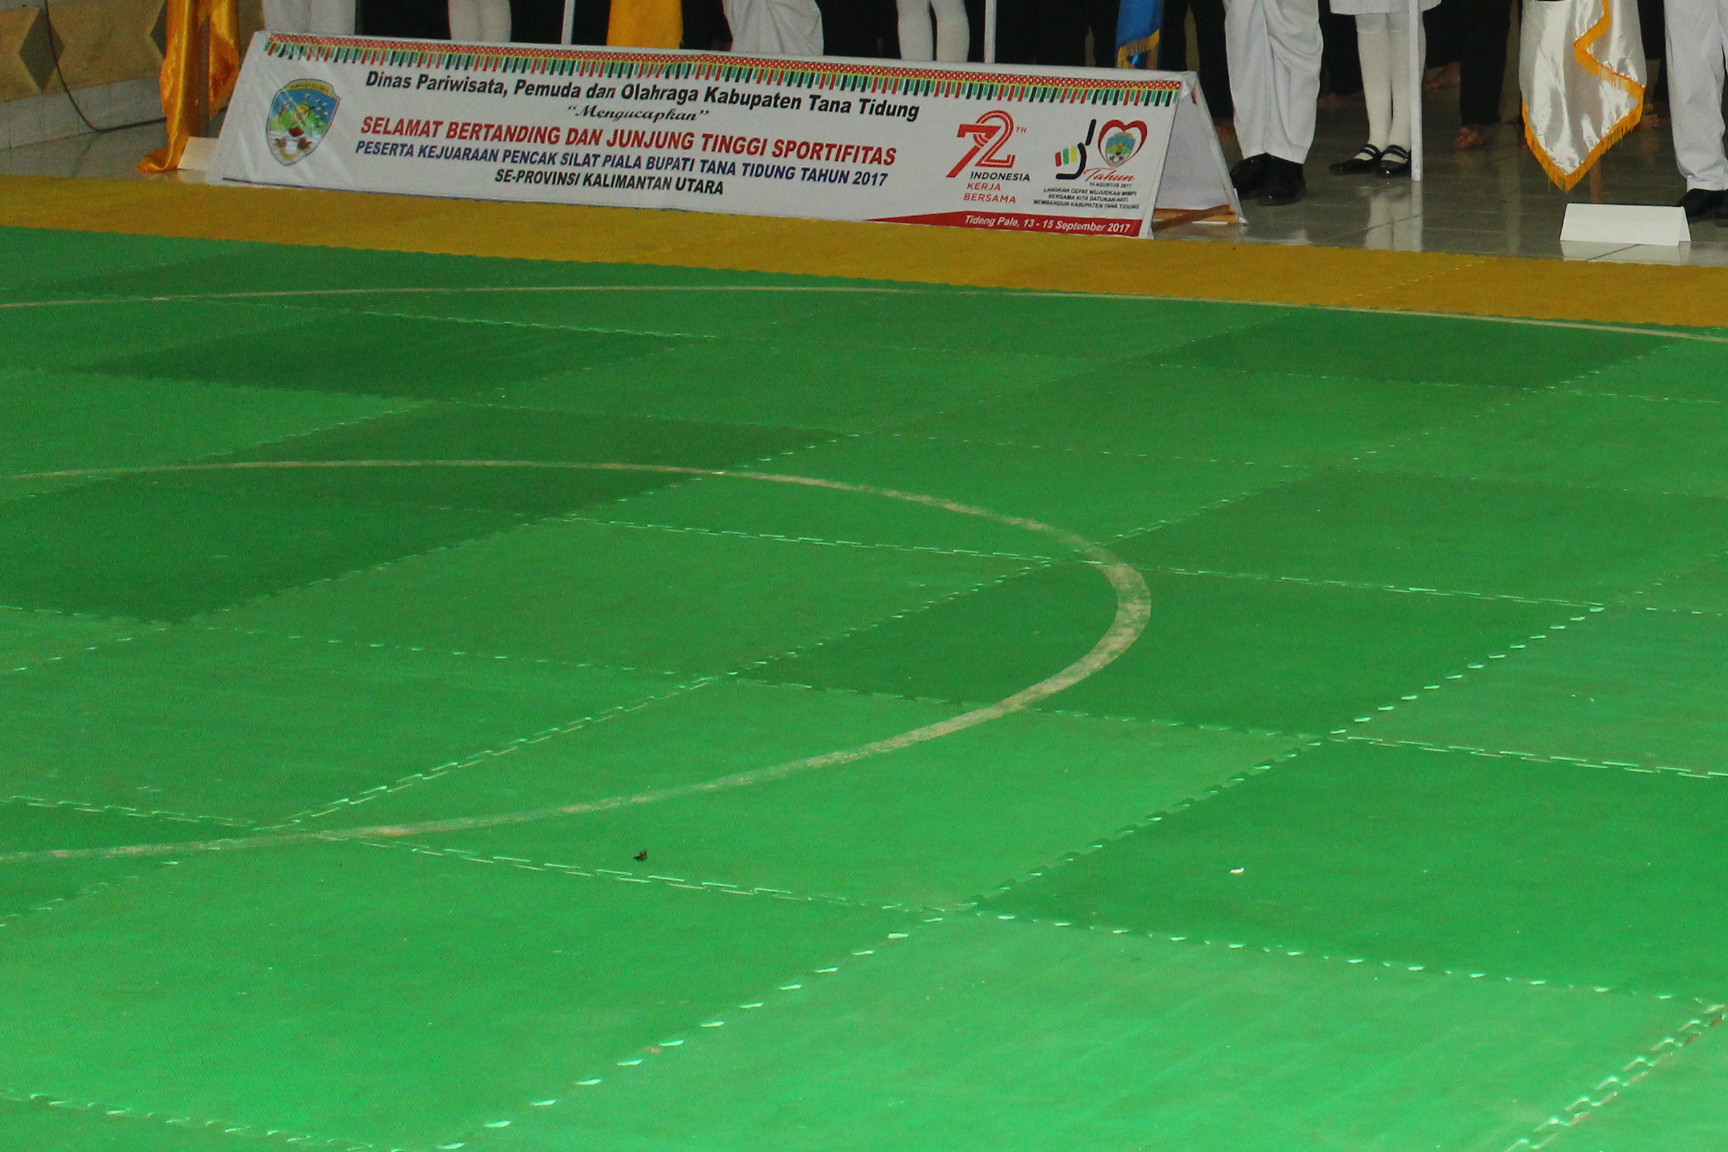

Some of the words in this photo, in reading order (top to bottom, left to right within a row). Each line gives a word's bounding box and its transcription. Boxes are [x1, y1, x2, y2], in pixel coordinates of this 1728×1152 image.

[366, 70, 411, 90] Dinas
[416, 74, 508, 97] Pariwisata,
[514, 79, 580, 98] Pemuda
[586, 82, 616, 100] dan
[621, 84, 698, 104] Olahraga
[704, 86, 802, 110] Kabupaten
[808, 94, 851, 114] Tana
[858, 98, 920, 122] Tidung
[361, 116, 444, 138] SELAMAT
[446, 121, 561, 145] BERTANDING
[565, 127, 604, 146] DAN
[606, 129, 695, 150] JUNJUNG
[701, 133, 767, 156] TINGGI
[772, 138, 898, 166] SPORTIFITAS
[946, 110, 1016, 178] 72
[356, 140, 414, 158] PESERTA
[418, 144, 498, 162] KEJUARAAN
[502, 149, 558, 166] PENCAK
[560, 152, 600, 168] SILAT
[602, 154, 642, 170] PIALA
[646, 156, 696, 172] BUPATI
[700, 160, 736, 176] TANA
[741, 162, 796, 180] TIDUNG
[800, 167, 850, 184] TAHUN
[852, 171, 888, 188] 2017
[1083, 168, 1136, 182] Tahun
[494, 168, 580, 186] SE-PROVINSI
[582, 172, 672, 191] KALIMANTAN
[676, 178, 724, 196] UTARA
[966, 182, 1002, 192] KERJA
[970, 172, 1030, 182] INDONESIA
[963, 192, 1016, 204] BERSAMA
[965, 215, 996, 226] Tideng
[997, 216, 1020, 228] Pale,
[1023, 218, 1034, 228] 13
[1042, 220, 1054, 228] 15
[1056, 220, 1106, 233] September
[1107, 222, 1131, 233] 2017
